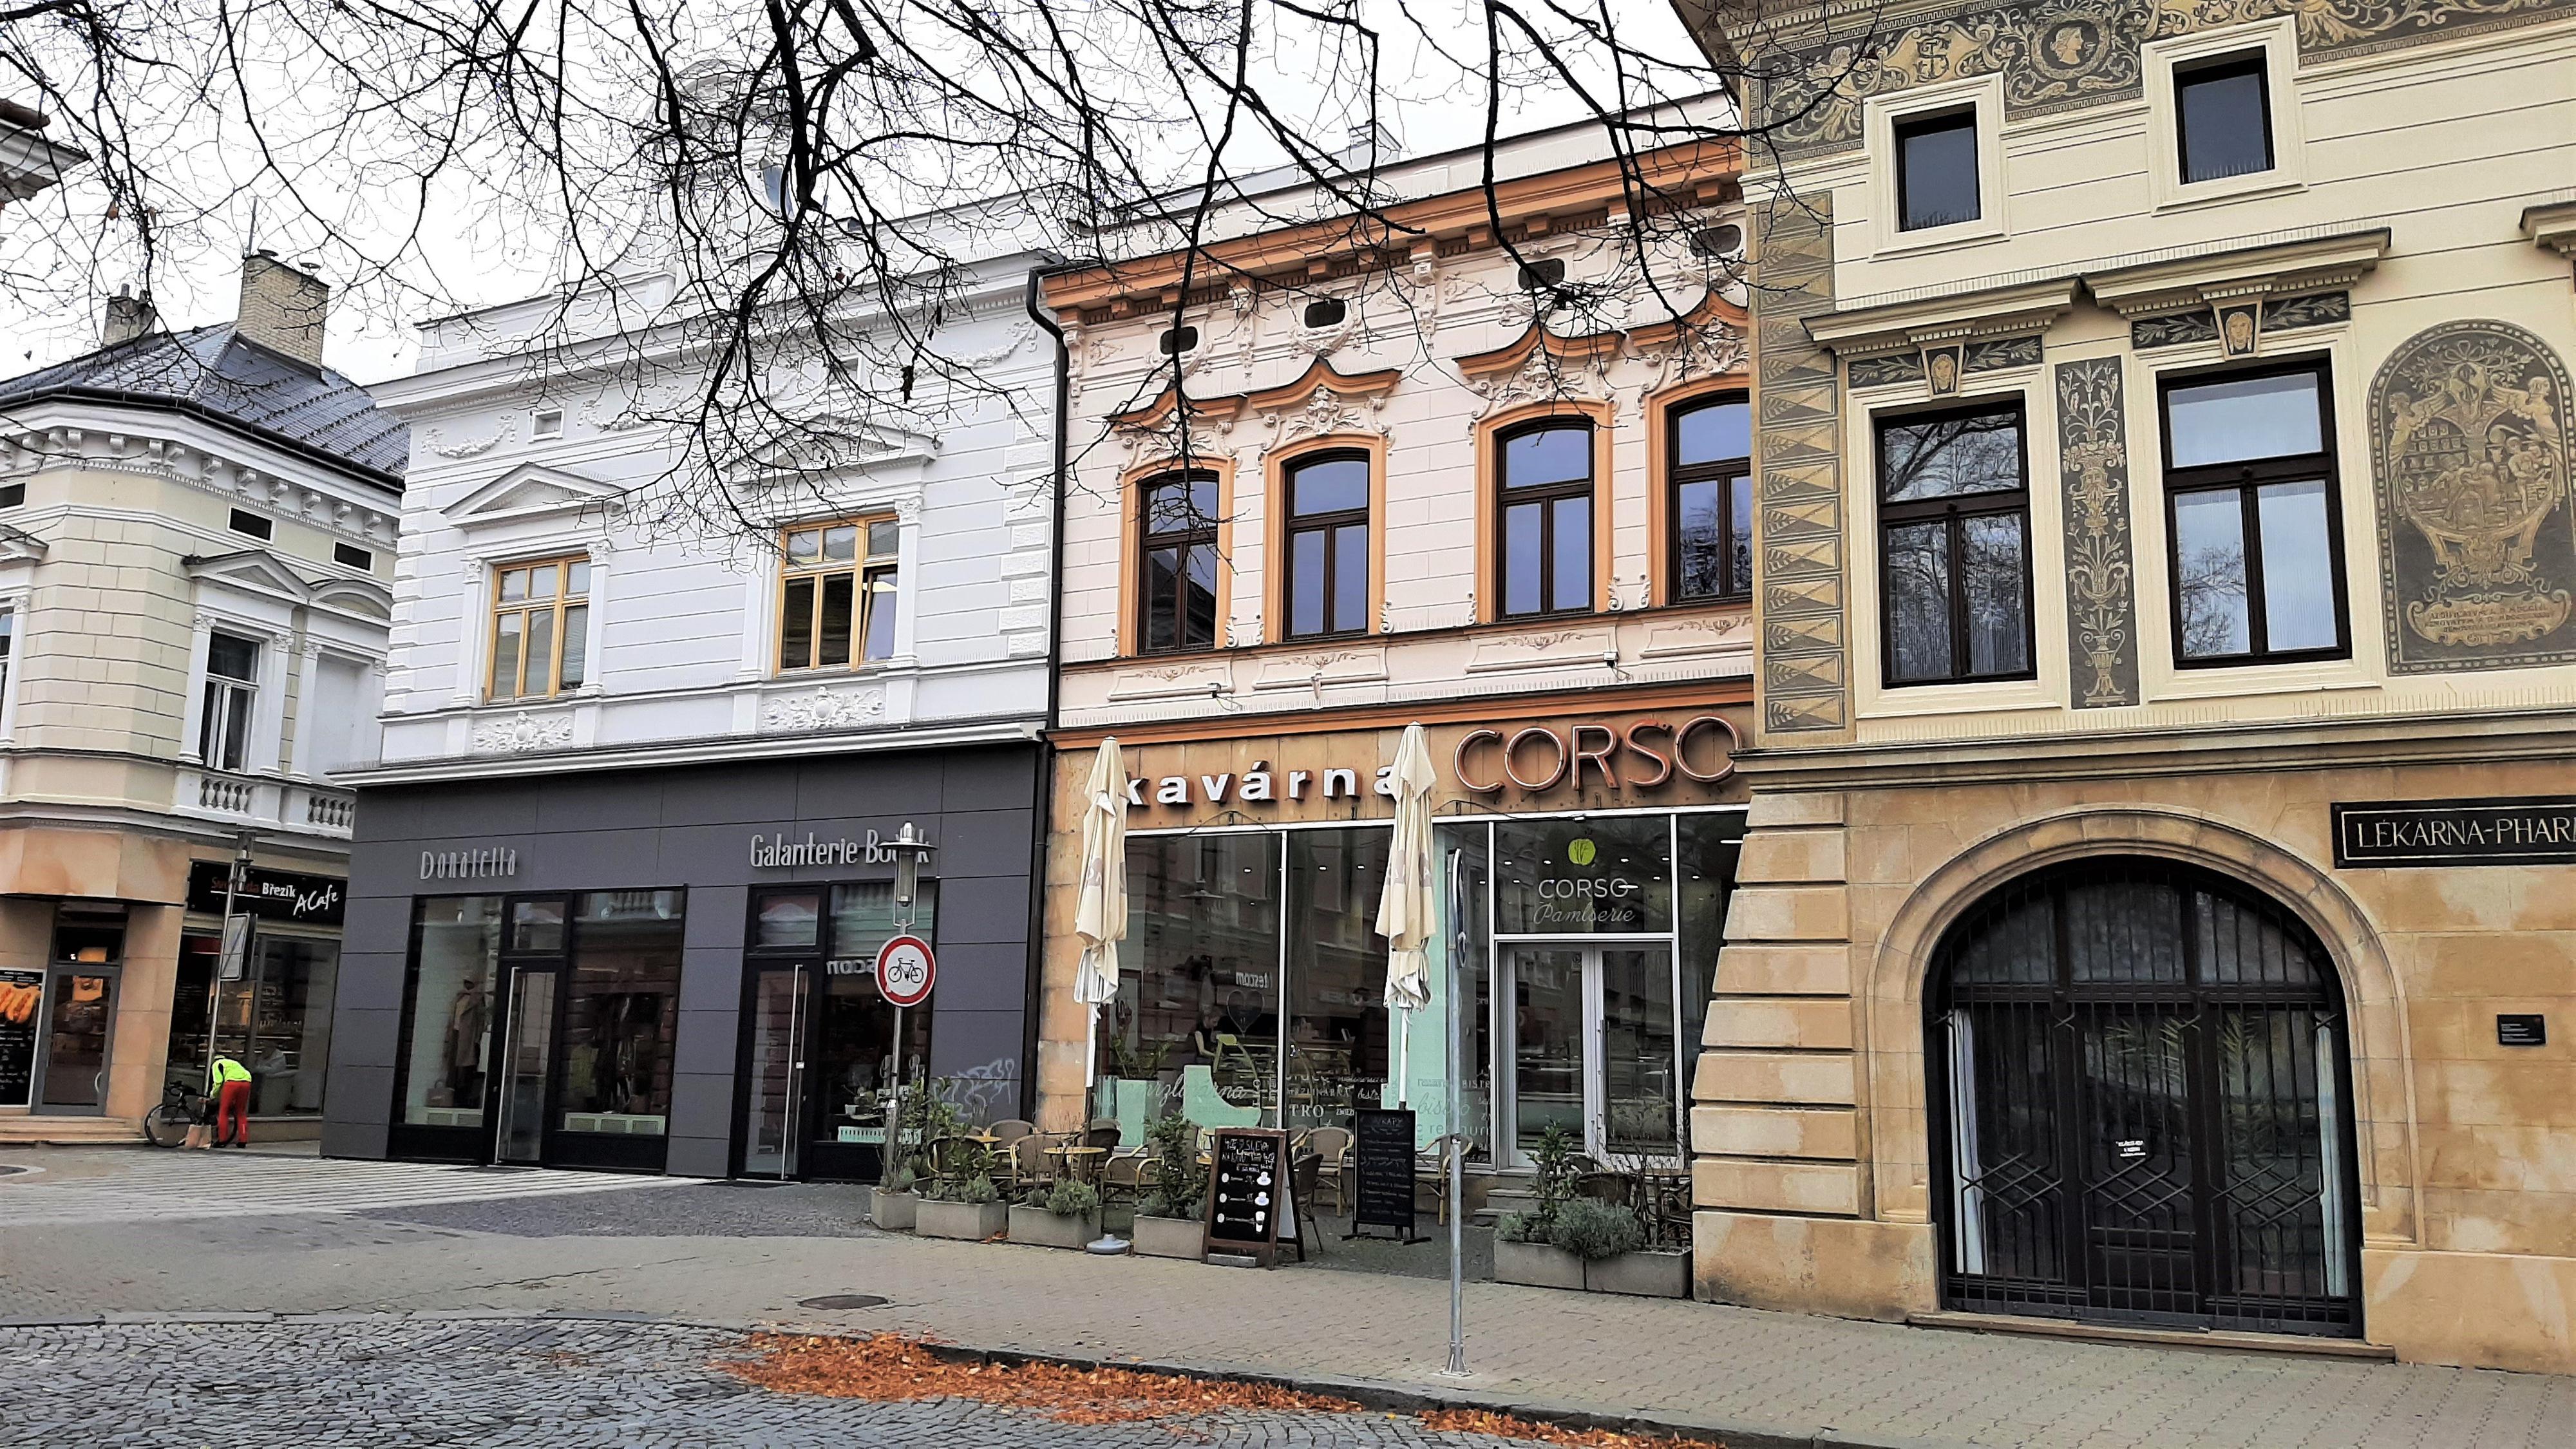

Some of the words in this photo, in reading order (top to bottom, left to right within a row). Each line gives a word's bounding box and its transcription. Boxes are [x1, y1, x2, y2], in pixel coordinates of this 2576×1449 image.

[1454, 715, 1741, 793] CORSO
[750, 831, 858, 867] Galanterie
[865, 828, 930, 864] Buk
[2357, 817, 2576, 848] LÉKÁRNA-PHAR
[420, 846, 516, 880] Donatella
[262, 882, 296, 898] Březík
[1538, 877, 1630, 898] CORSO
